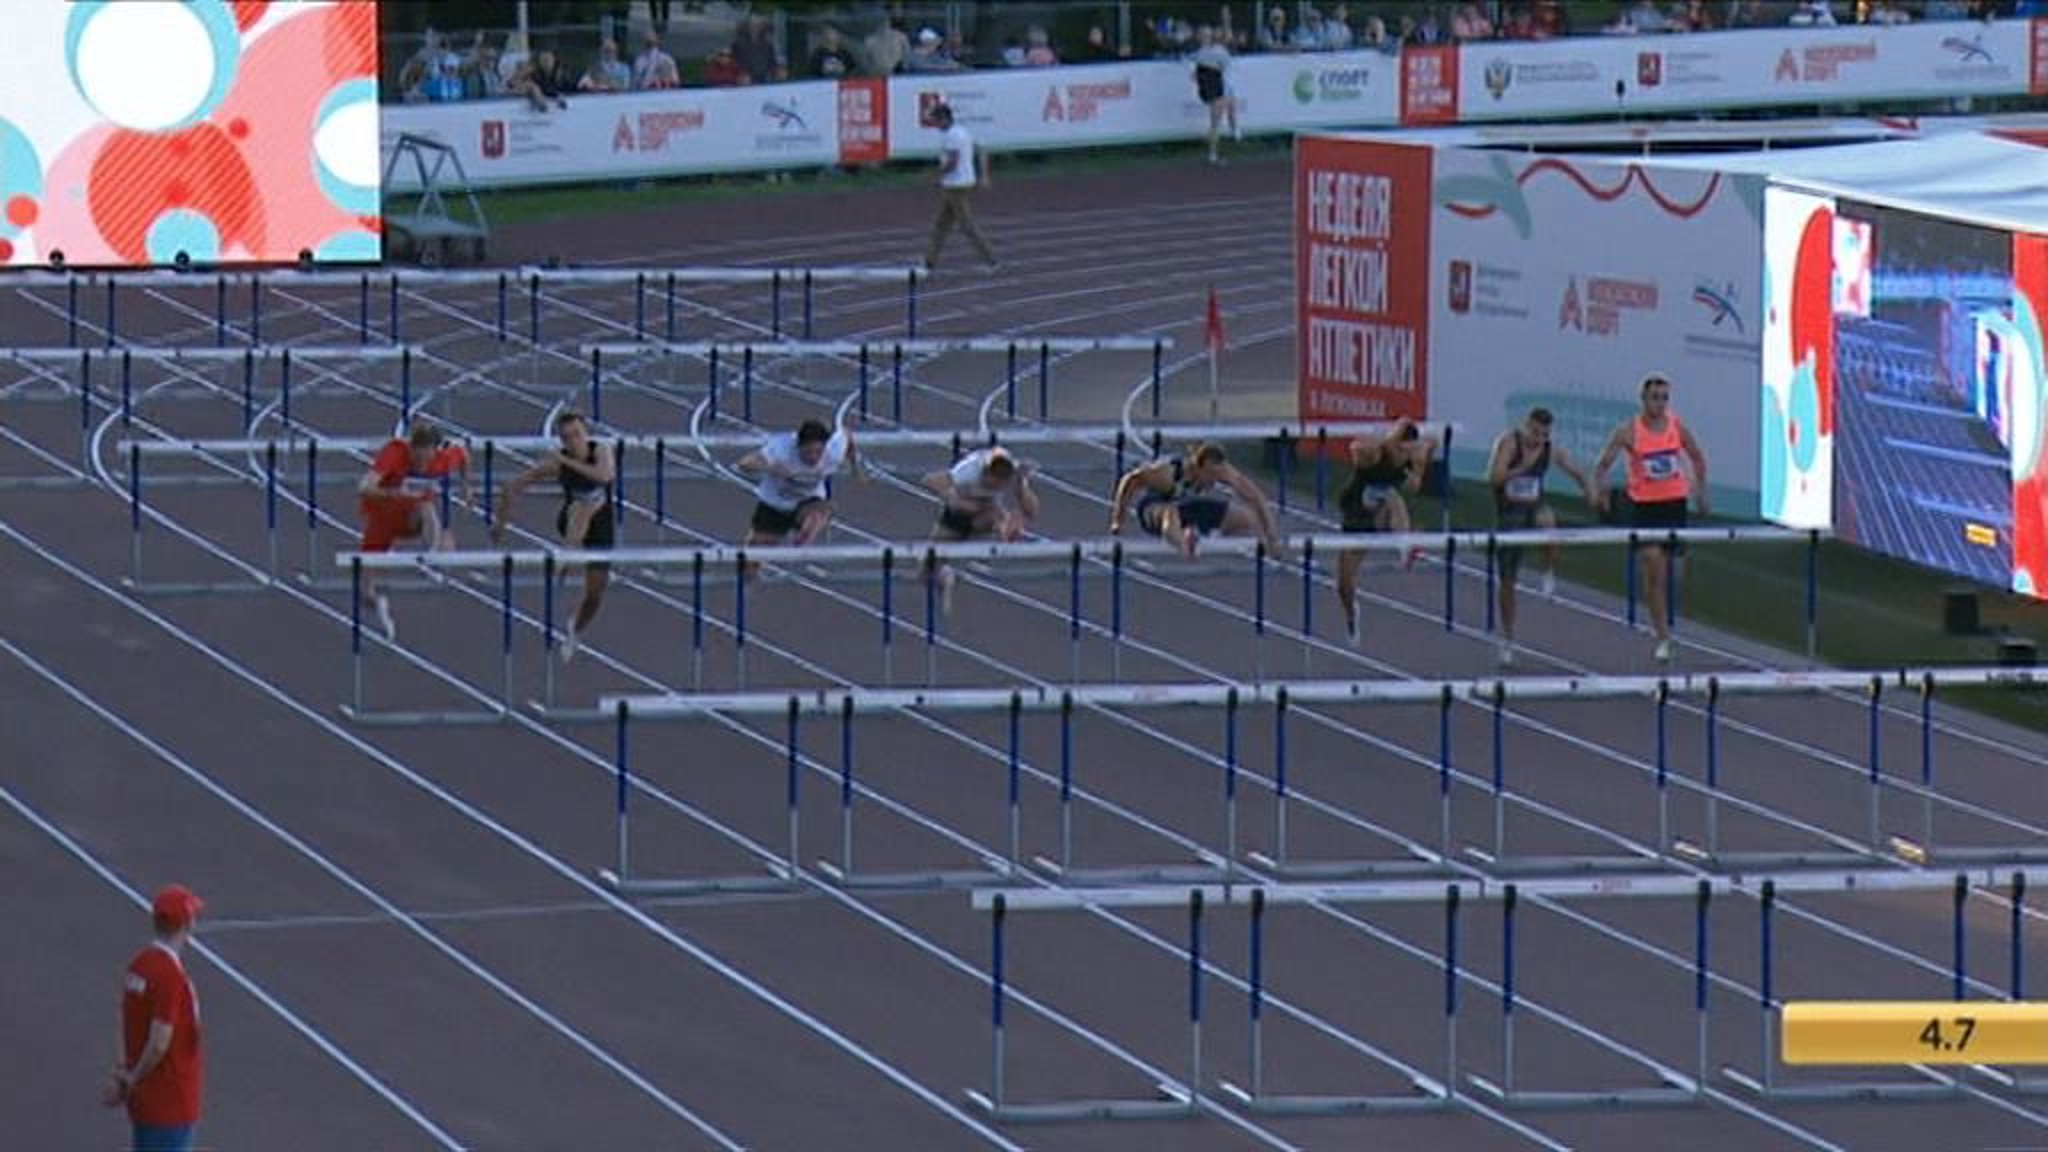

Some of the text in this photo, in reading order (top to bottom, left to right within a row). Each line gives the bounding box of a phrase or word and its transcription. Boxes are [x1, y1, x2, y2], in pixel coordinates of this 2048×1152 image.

[1308, 170, 1391, 240] НЕДЕЛЯ
[1309, 241, 1388, 314] ЛЕГКОЙ
[1309, 317, 1414, 391] АТЛЕТИКИ
